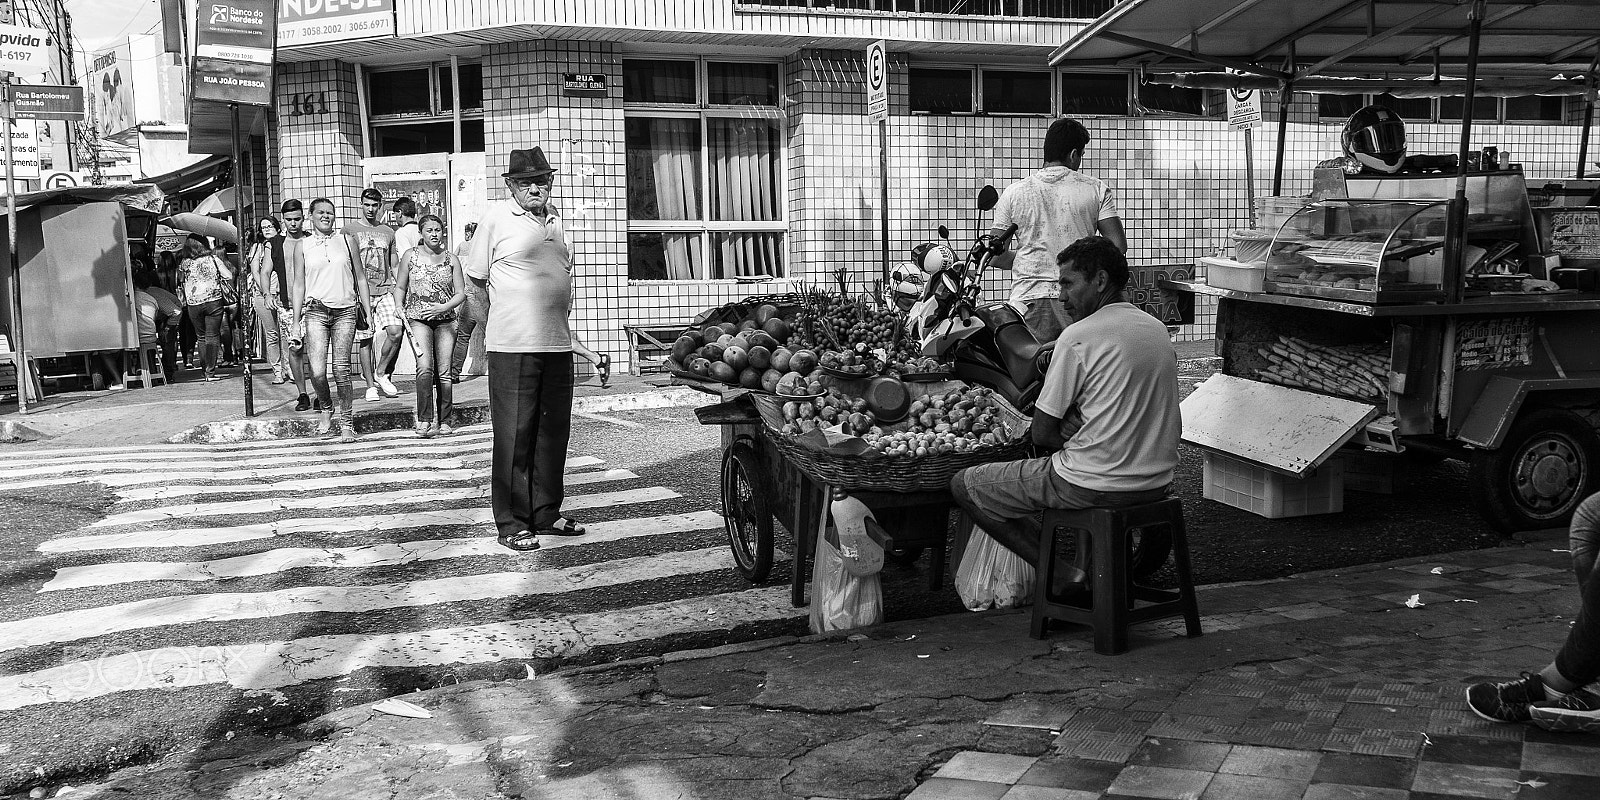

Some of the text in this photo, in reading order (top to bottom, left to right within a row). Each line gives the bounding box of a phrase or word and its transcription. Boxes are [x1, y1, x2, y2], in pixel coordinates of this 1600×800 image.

[230, 7, 264, 18] Banco do
[230, 15, 264, 25] Nordeste
[302, 23, 342, 37] 3058.2002
[349, 18, 389, 32] 3065.6971
[0, 33, 41, 47] pvida
[873, 54, 880, 81] E
[203, 76, 266, 88] RUA JOÃO PESSOA
[15, 91, 70, 100] Rua Bartolomeu
[290, 91, 329, 116] 161
[1234, 101, 1248, 110] CARGA
[0, 159, 38, 167] toamento
[389, 188, 397, 198] 12
[1554, 214, 1599, 227] Caldo de Cana
[1125, 268, 1190, 290] ALDO
[1145, 301, 1182, 322] NA
[1462, 324, 1528, 339] Caldo de Cana
[1461, 342, 1485, 351] Pequeno
